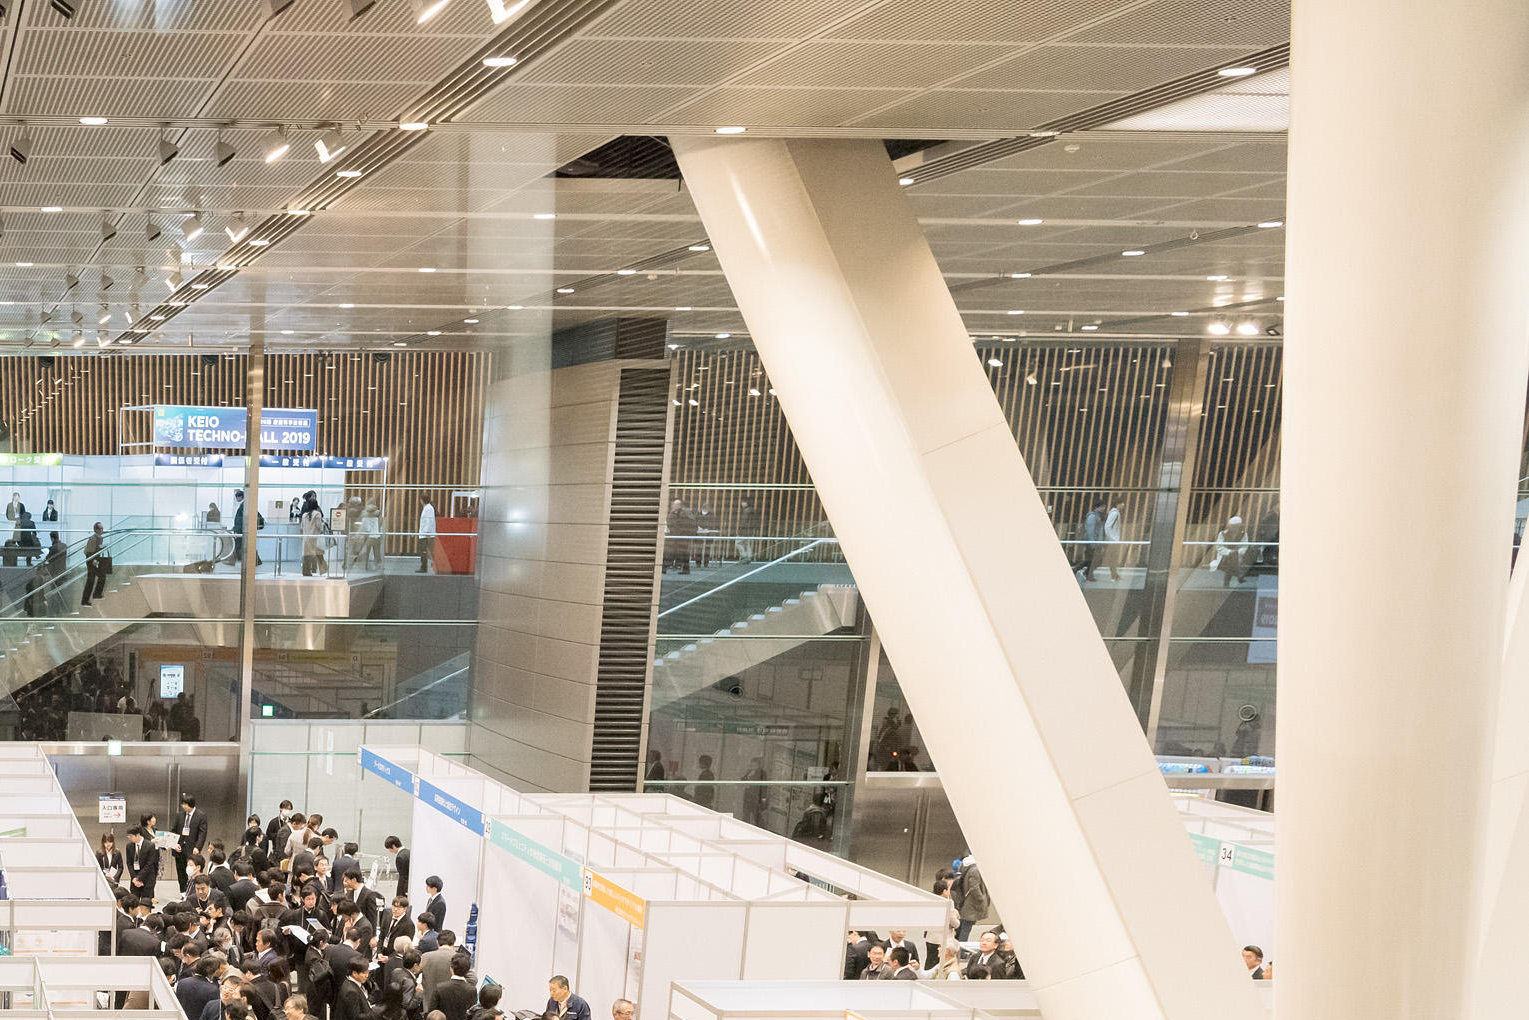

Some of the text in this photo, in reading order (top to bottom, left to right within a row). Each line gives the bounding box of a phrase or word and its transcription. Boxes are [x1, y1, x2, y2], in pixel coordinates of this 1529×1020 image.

[188, 416, 219, 428] KEIO
[282, 431, 311, 444] 2019
[1221, 847, 1233, 861] 34
